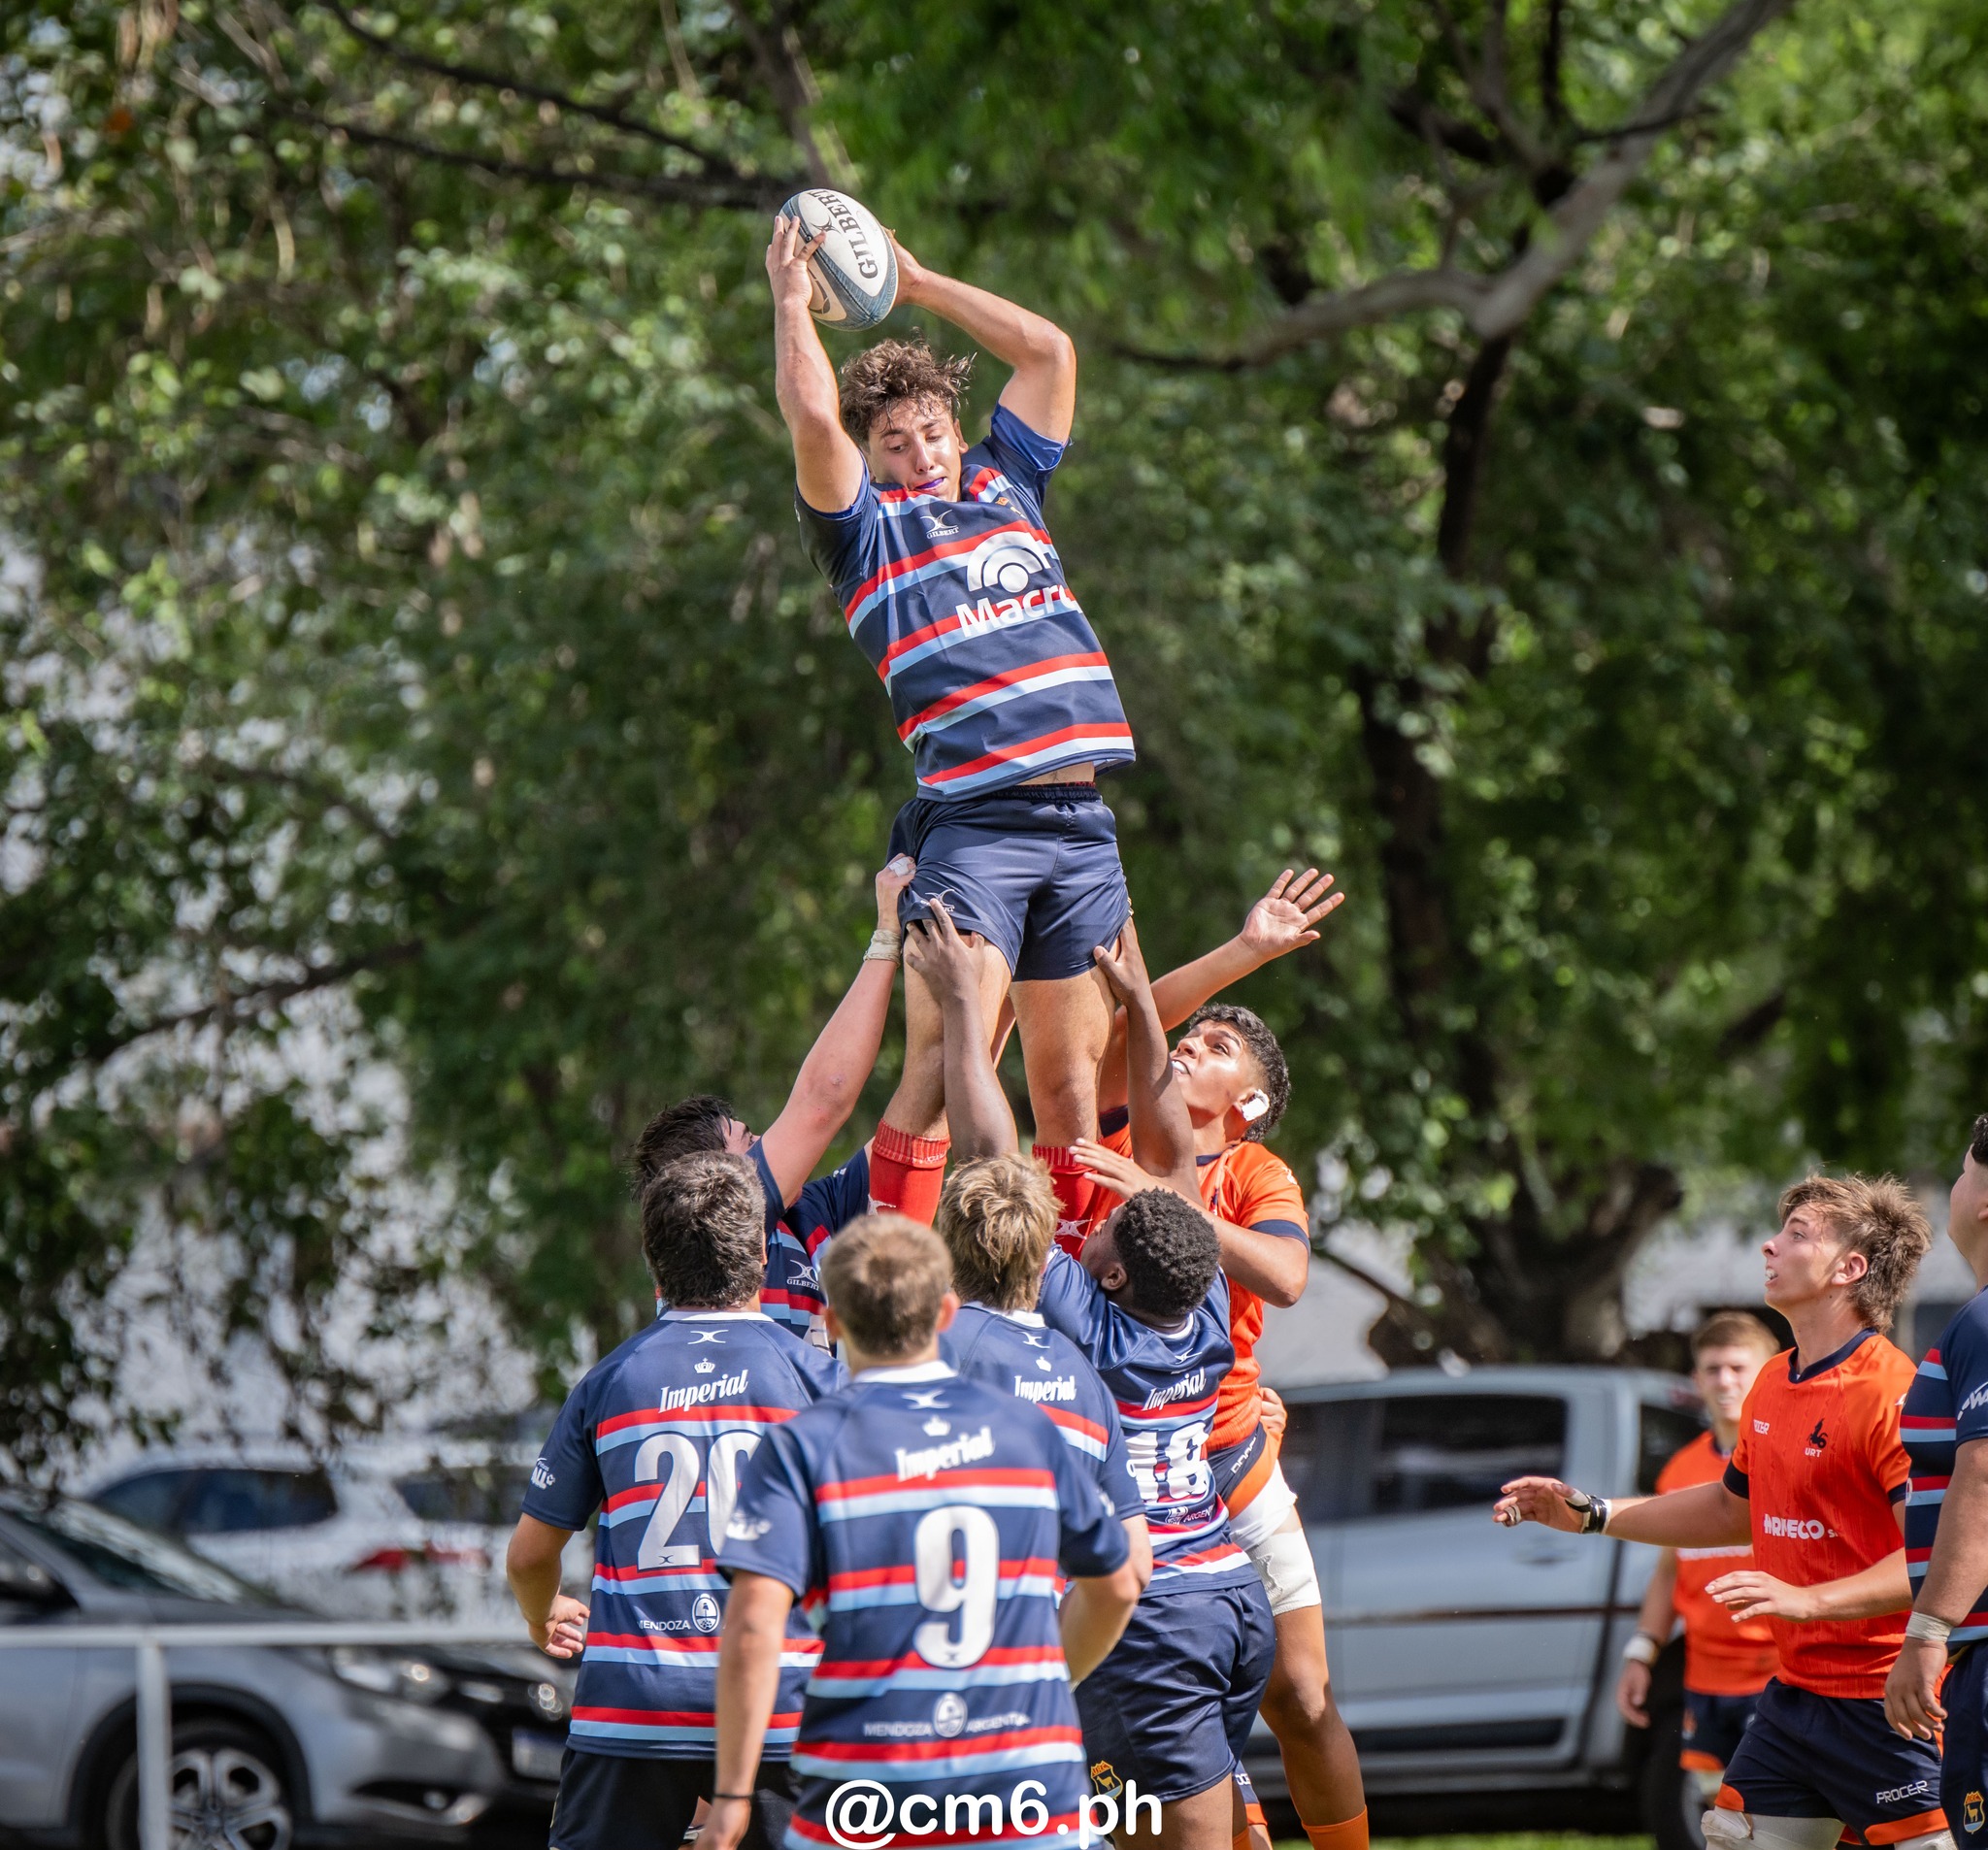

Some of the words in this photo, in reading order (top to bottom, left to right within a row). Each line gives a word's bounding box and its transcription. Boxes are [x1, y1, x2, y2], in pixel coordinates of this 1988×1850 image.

[808, 189, 879, 280] GILBERT
[926, 526, 960, 540] GILBERT
[786, 1278, 820, 1291] GILBERT
[657, 1369, 749, 1414] Imperial
[1014, 1374, 1077, 1404] Imperial
[1142, 1366, 1207, 1411] Imperial
[895, 1425, 996, 1483] Imperial
[1126, 1421, 1209, 1504] 18
[1805, 1447, 1823, 1458] URT
[913, 1504, 1000, 1669] 9
[863, 1722, 934, 1737] MENDOZA
[1875, 1779, 1930, 1804] PROCER
